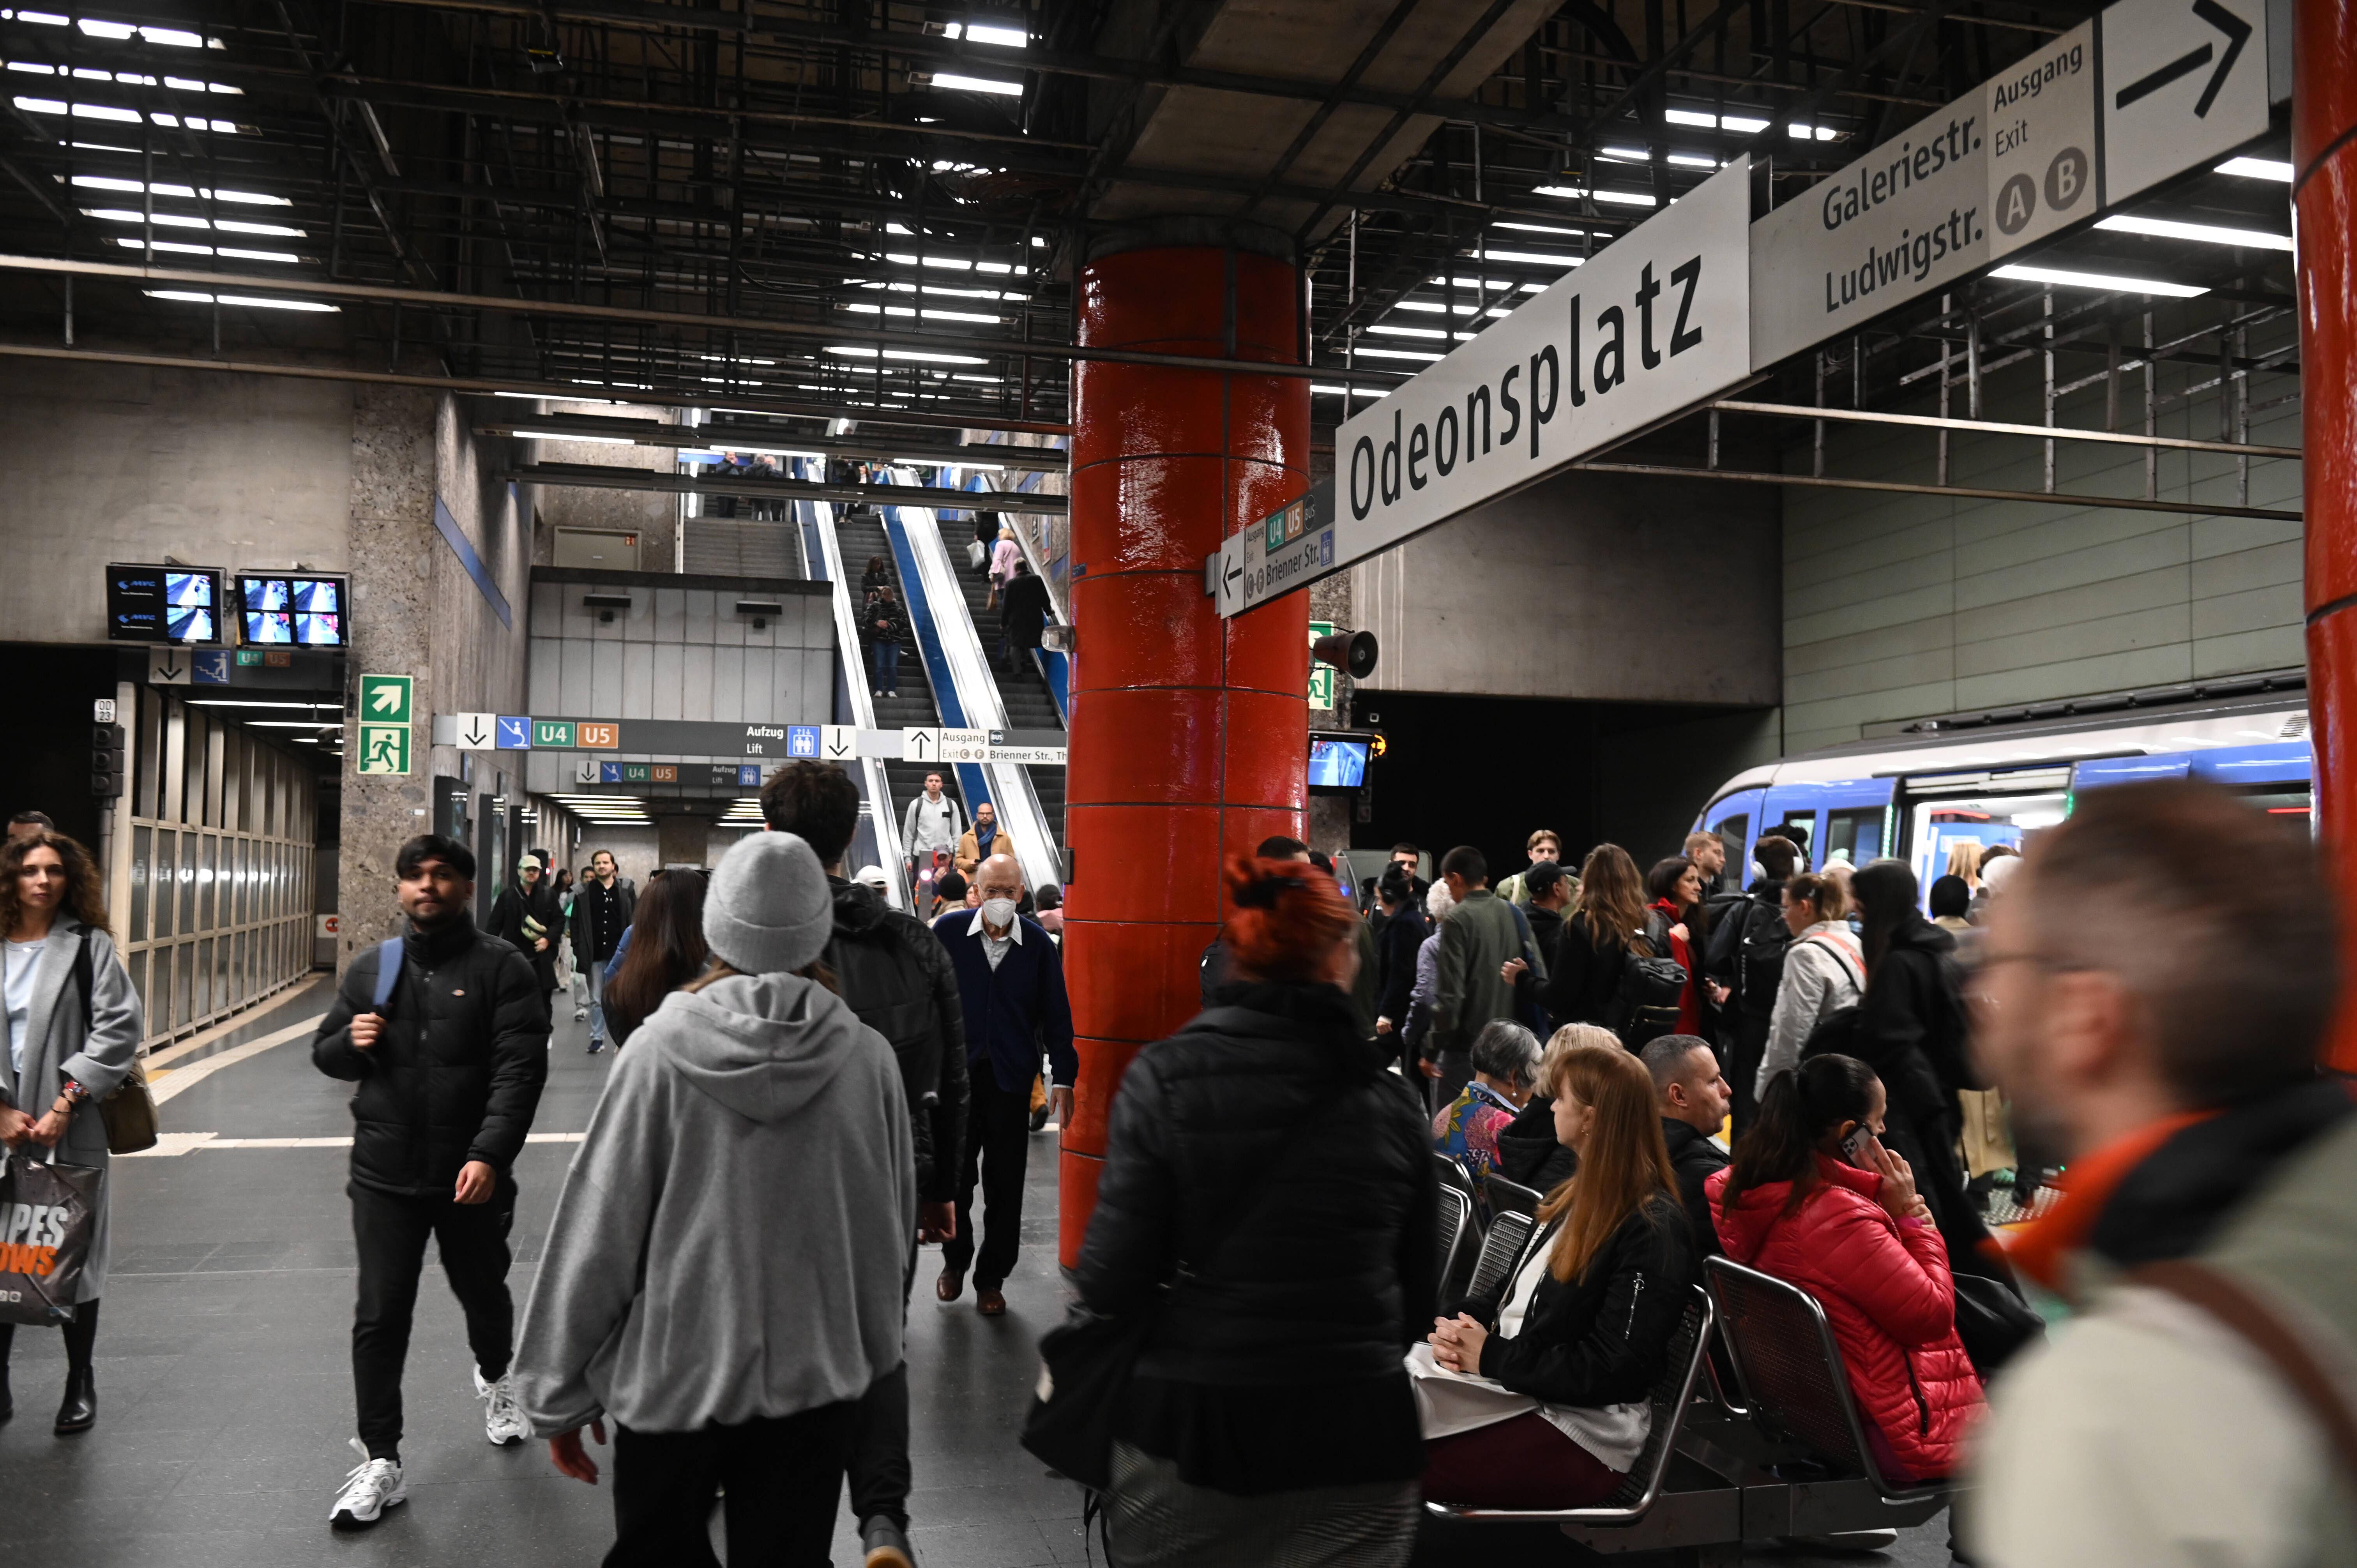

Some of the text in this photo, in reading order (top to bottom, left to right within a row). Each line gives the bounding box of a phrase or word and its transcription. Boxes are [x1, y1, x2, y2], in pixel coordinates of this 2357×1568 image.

[1994, 43, 2082, 112] Ausgang
[1995, 119, 2028, 157] Exit
[1823, 116, 1981, 230] Galeriestr.
[1827, 207, 1983, 313] Ludwigstr.
[1350, 254, 1701, 521] Odeonsplatz
[1270, 504, 1315, 543] U4 U5 BUS
[1267, 544, 1319, 586] Brienner Str.
[242, 653, 258, 663] U4
[541, 726, 610, 744] U4 U5
[746, 726, 784, 740] Aufzug
[942, 732, 985, 744] Ausgang
[747, 743, 763, 754] Lift
[942, 749, 958, 758] Exit
[990, 750, 1032, 759] Brienner
[1035, 751, 1053, 761] Str.,
[629, 768, 672, 779] U4 U5
[712, 766, 736, 775] Aufzug
